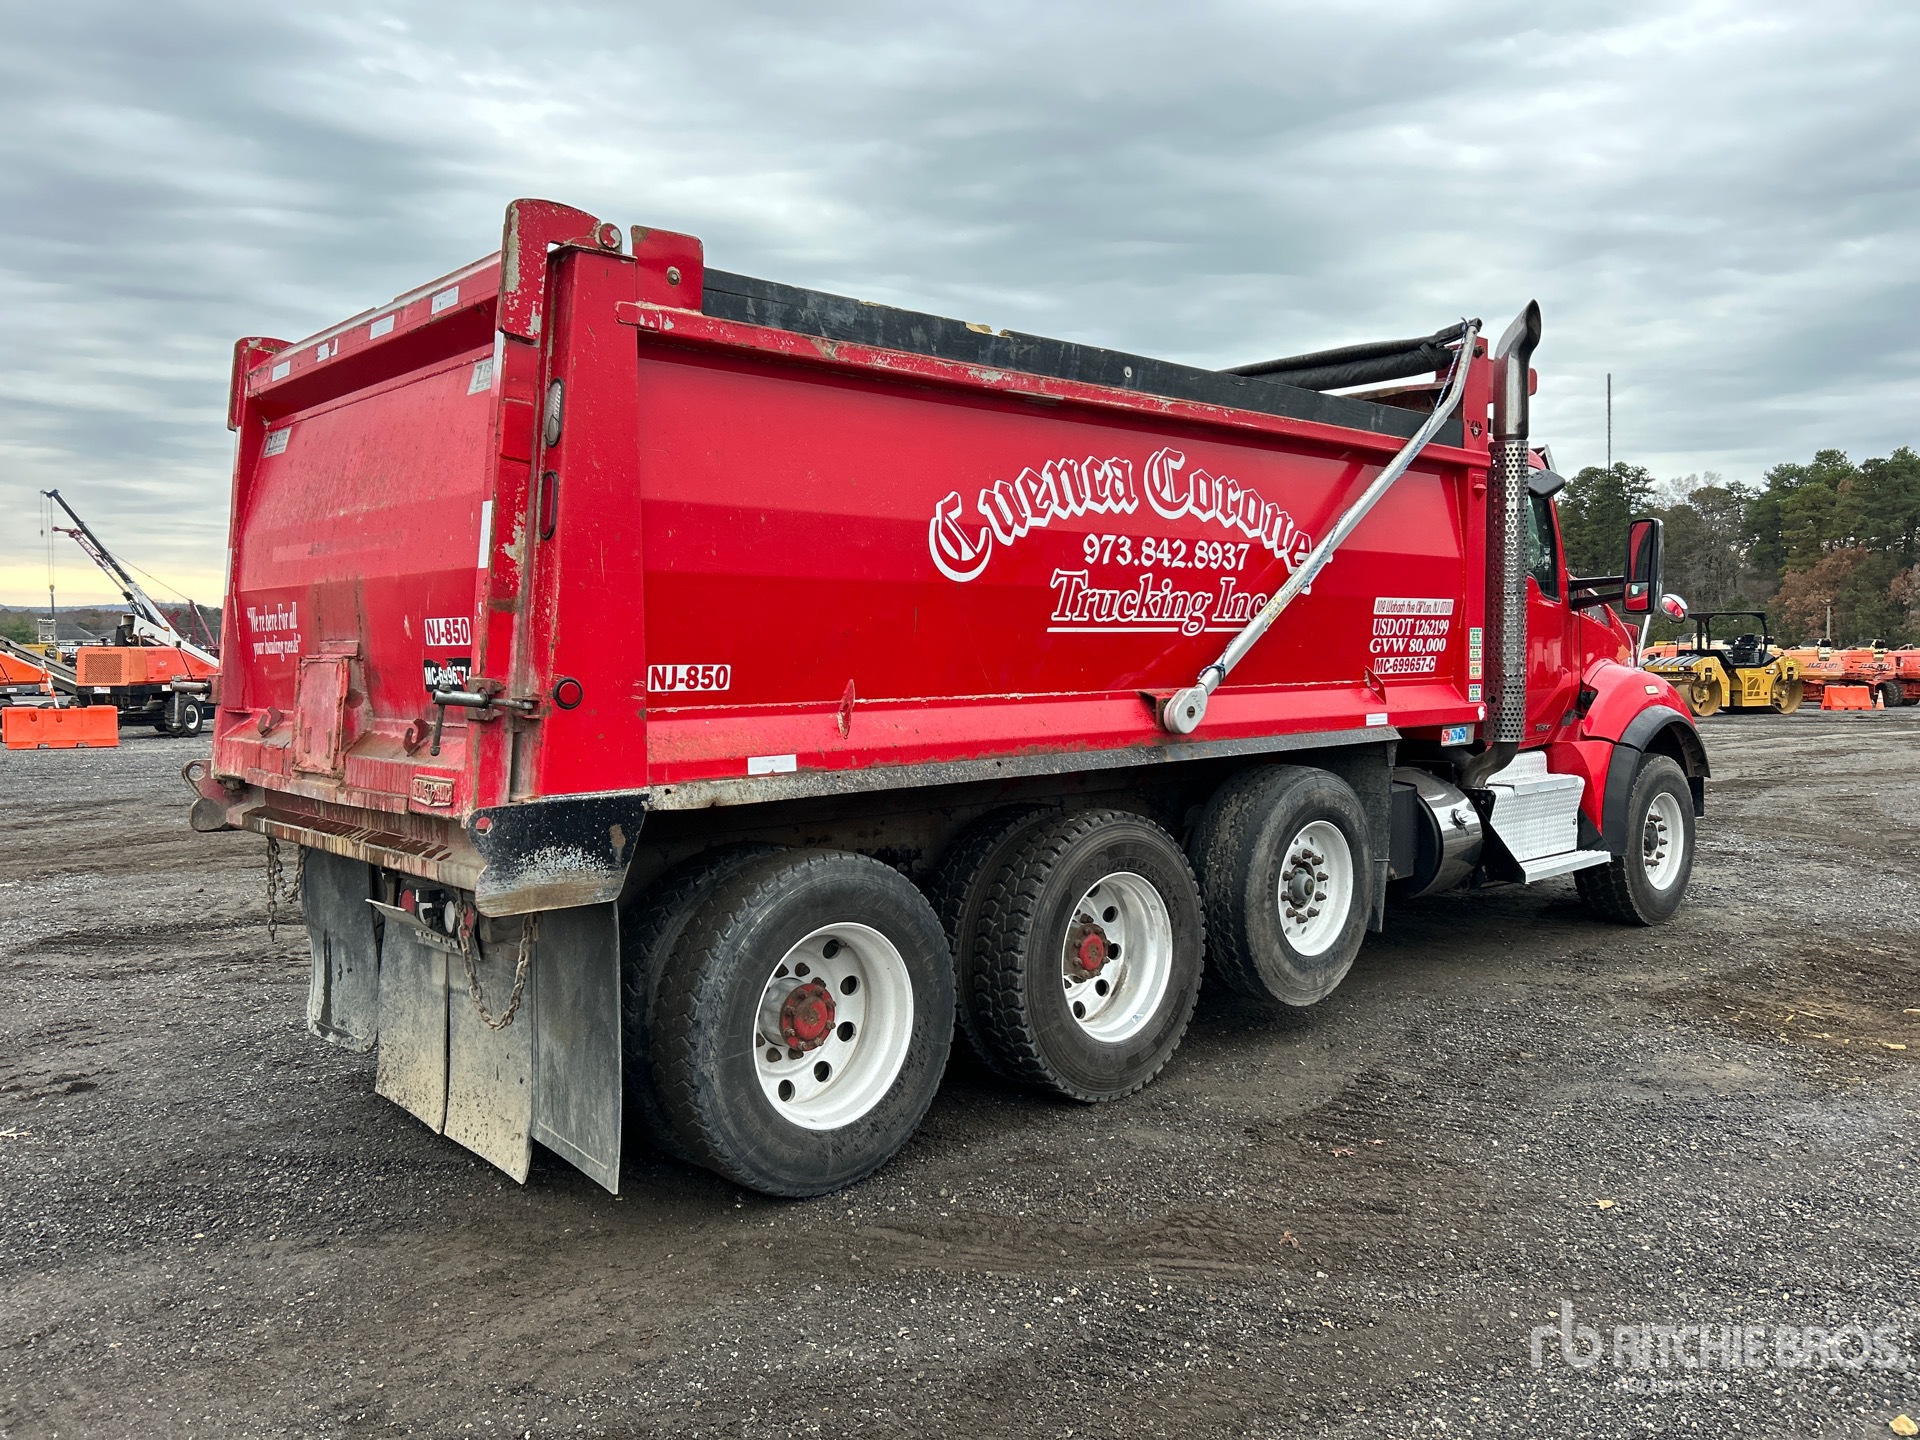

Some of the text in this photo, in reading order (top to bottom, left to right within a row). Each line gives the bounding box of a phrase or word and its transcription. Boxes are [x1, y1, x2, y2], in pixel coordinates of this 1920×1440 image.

[928, 447, 1333, 596] Cuenca Corone
[1083, 532, 1251, 571] 973.842.8937
[289, 601, 298, 629] all
[1050, 568, 1216, 636] Trucking
[426, 618, 469, 645] NJ-850
[1372, 618, 1450, 636] USDOT 1262199
[1369, 637, 1446, 655] GVW 80,000
[650, 665, 729, 690] NJ-850
[1374, 657, 1435, 674] MC-699657-C
